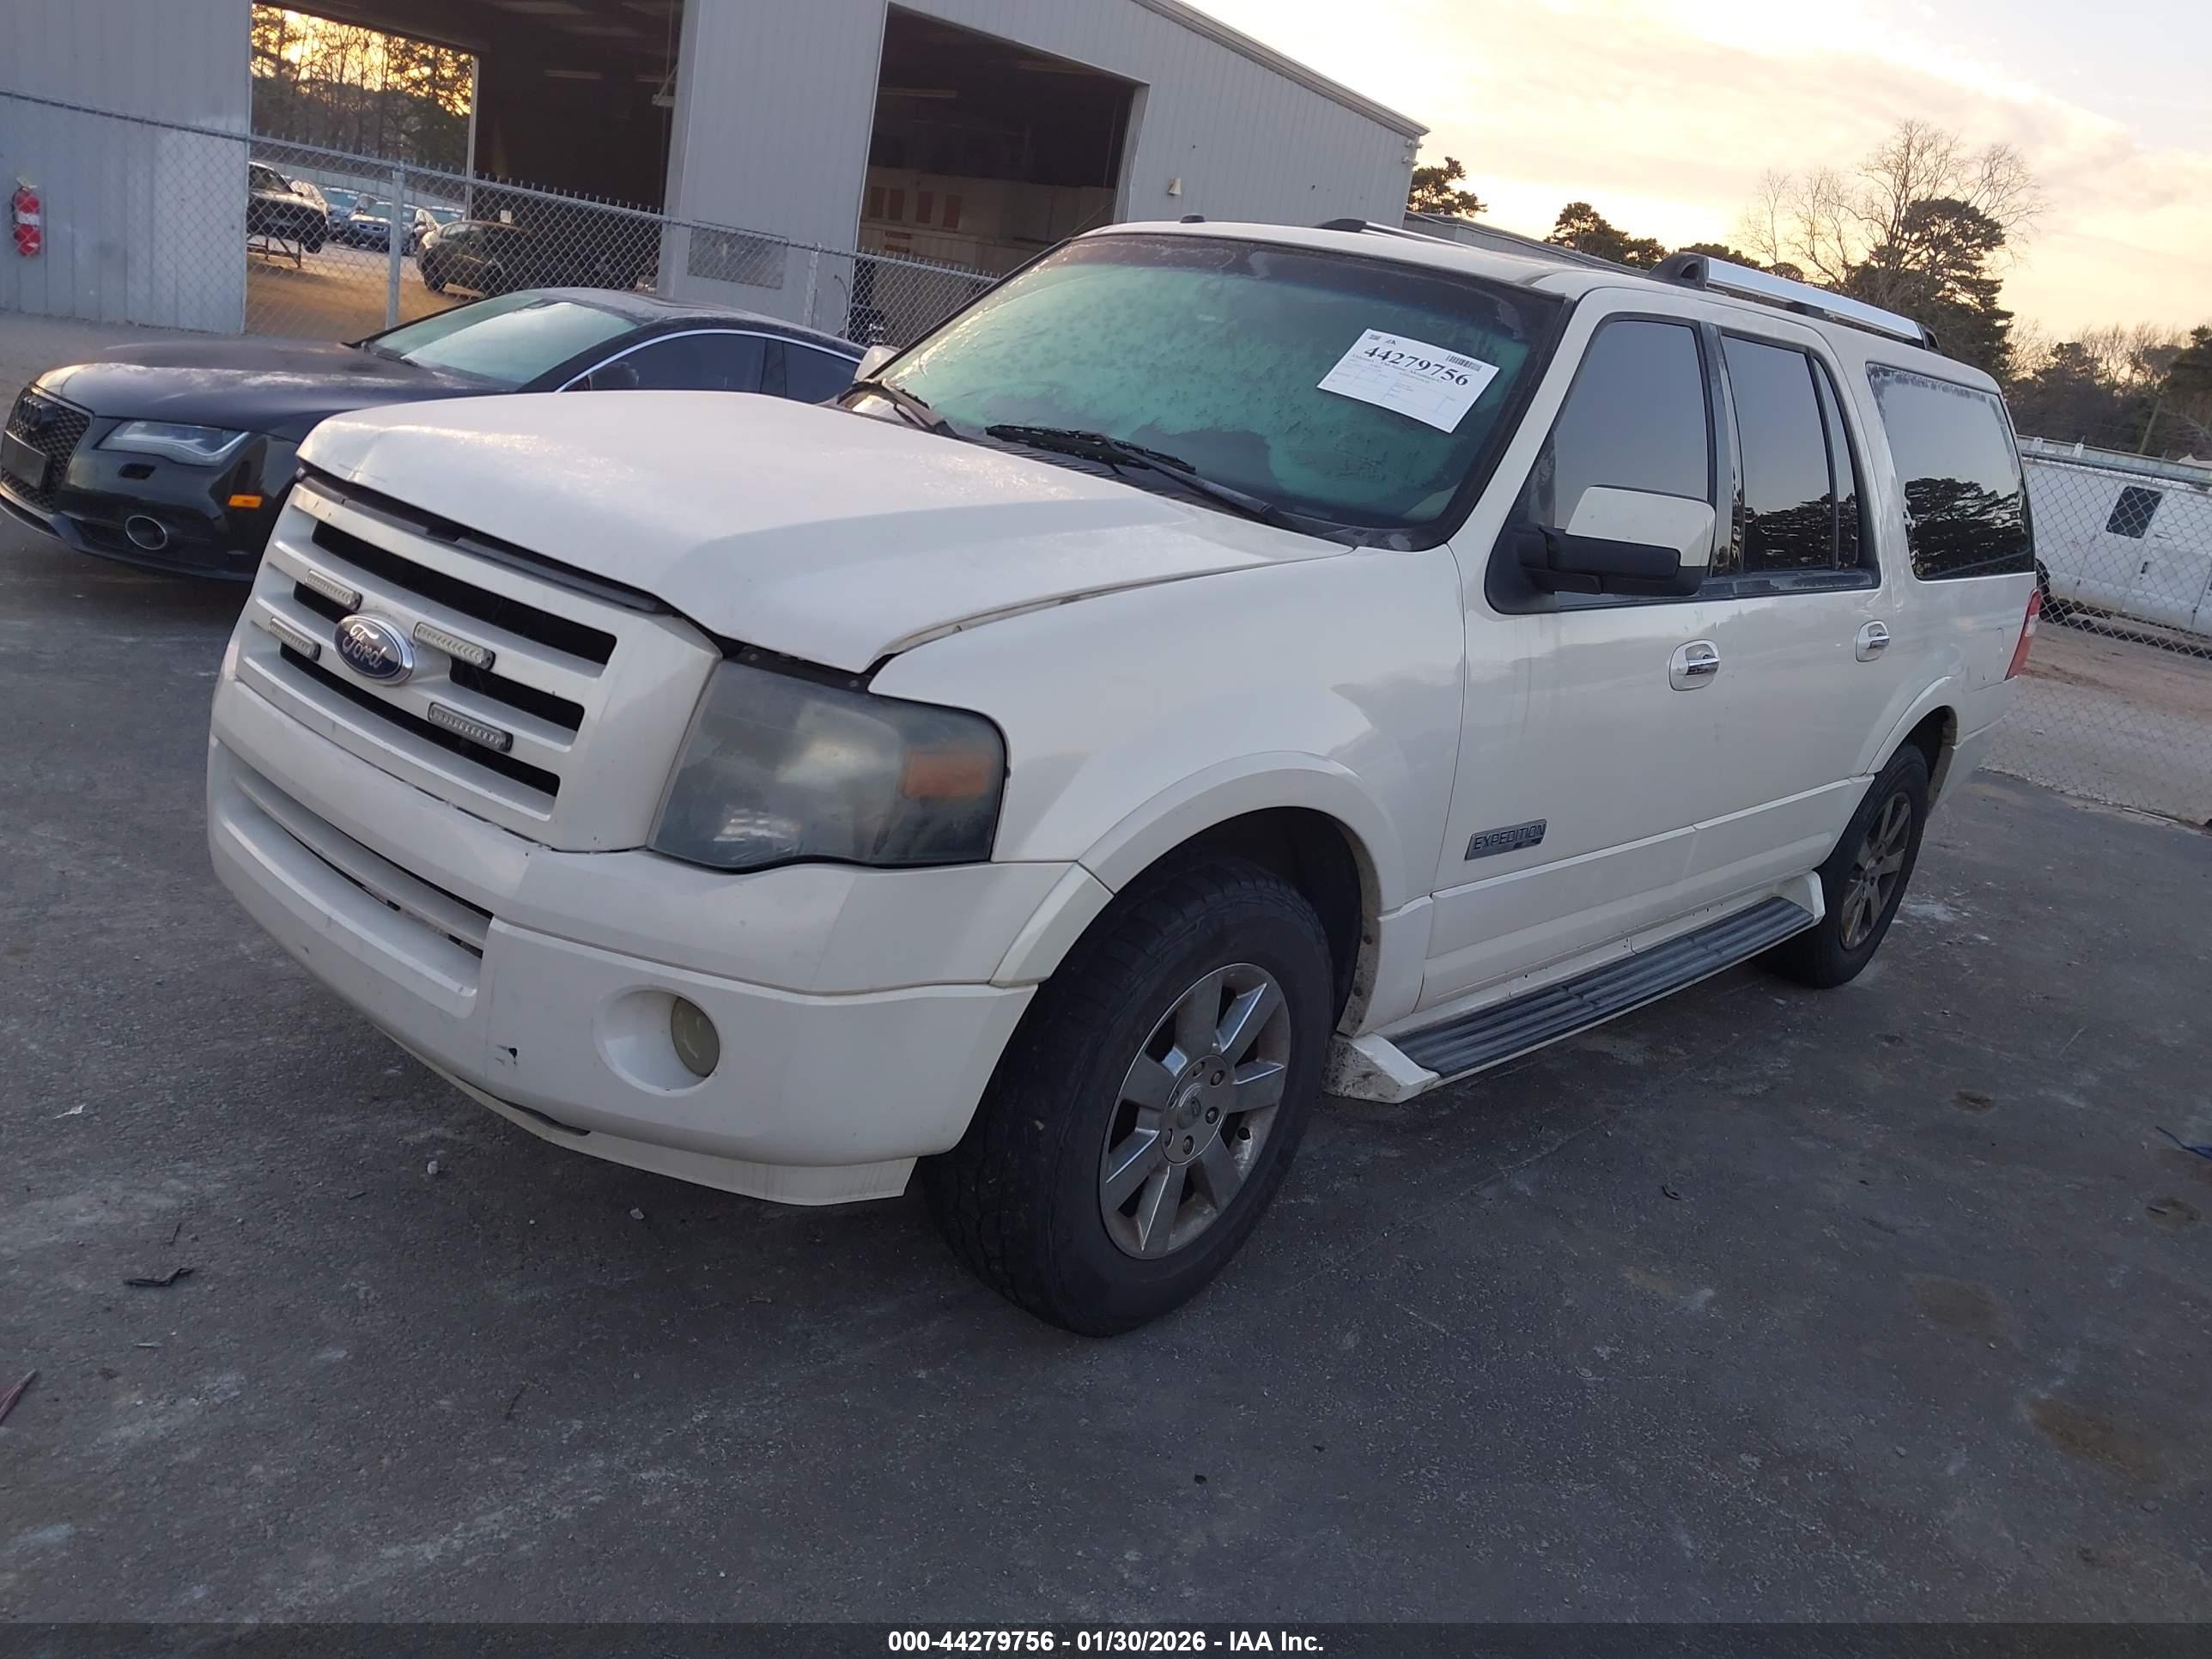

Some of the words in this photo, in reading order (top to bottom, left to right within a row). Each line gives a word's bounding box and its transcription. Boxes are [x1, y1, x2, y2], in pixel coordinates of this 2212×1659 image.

[1364, 346, 1473, 386] 44279756
[342, 623, 387, 669] Ford
[1473, 823, 1547, 850] EXPEDITION
